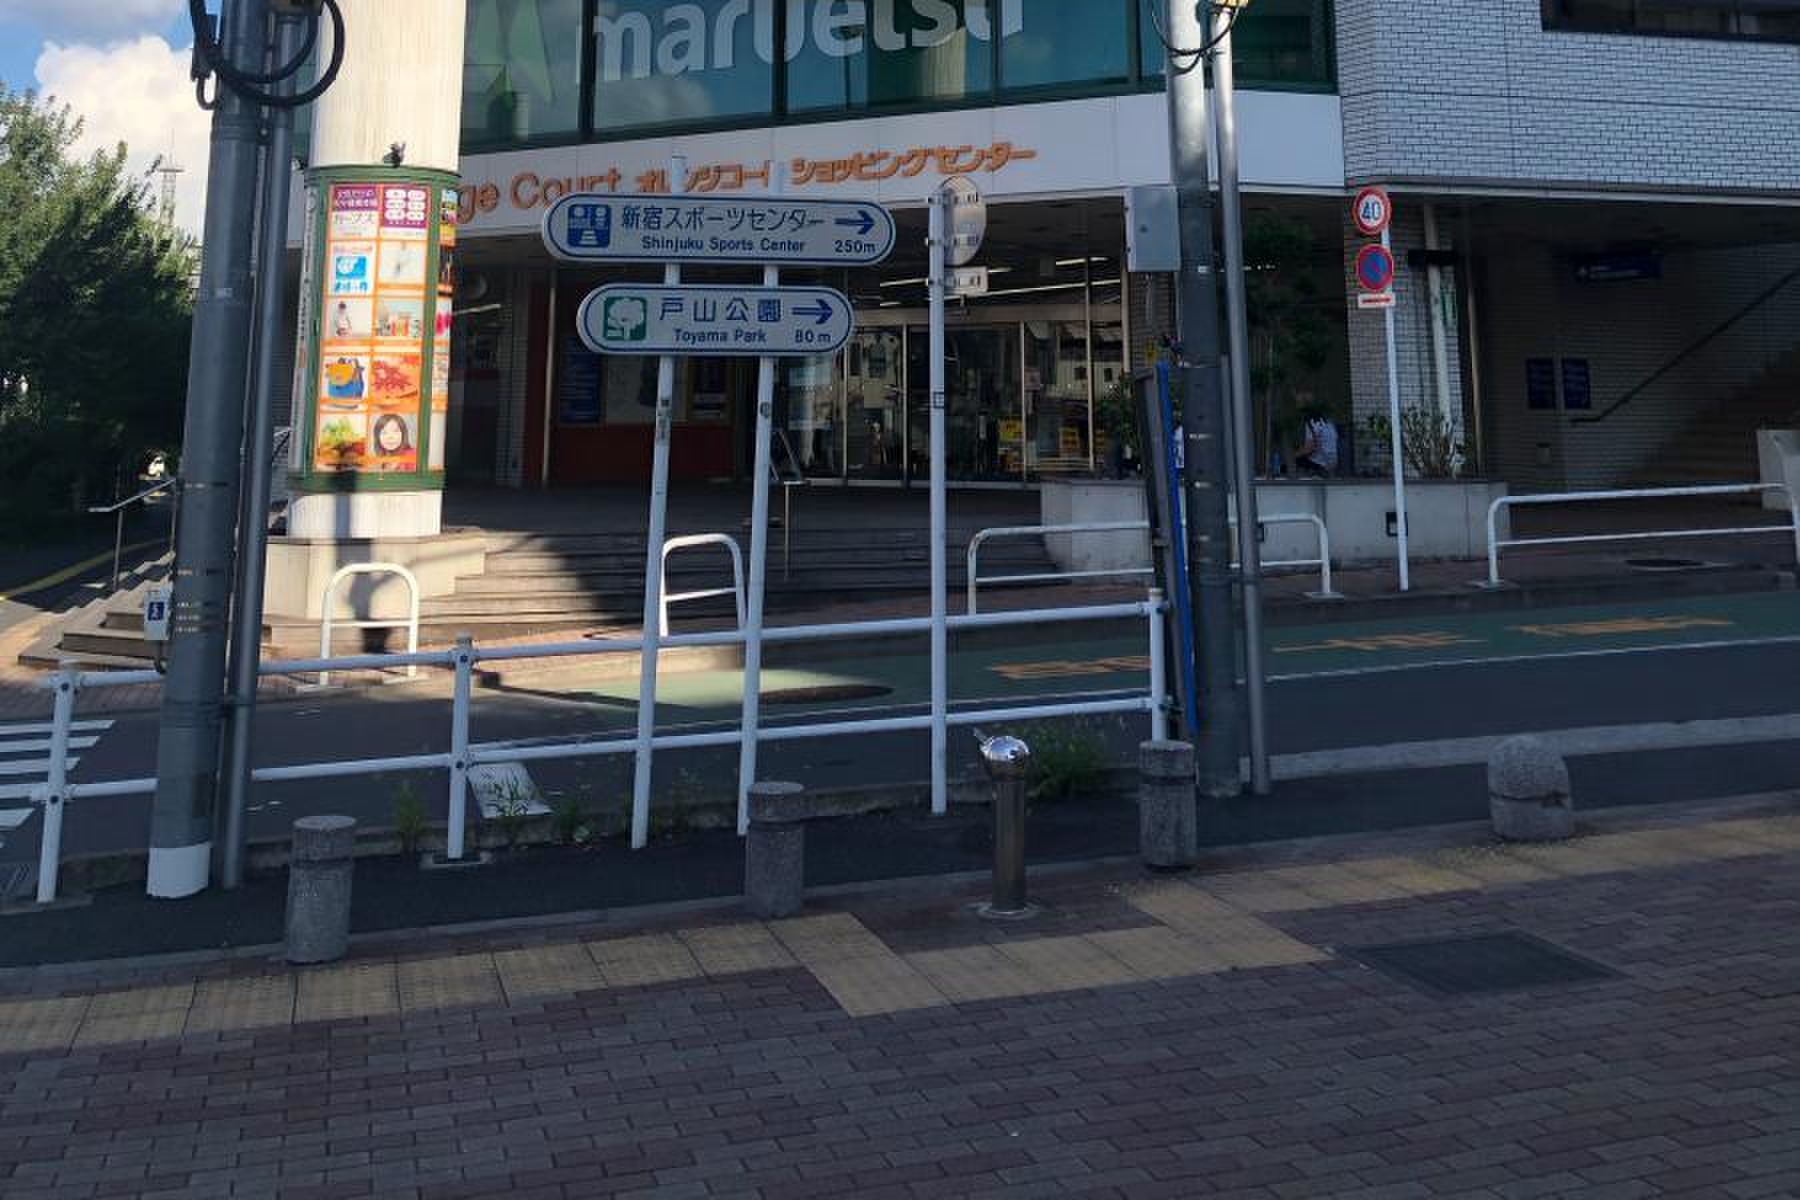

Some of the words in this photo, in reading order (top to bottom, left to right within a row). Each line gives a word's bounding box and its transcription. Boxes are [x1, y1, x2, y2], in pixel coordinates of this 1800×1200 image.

[791, 141, 1037, 186] ショッピングセンター
[621, 207, 824, 232] 新宿スポーツセンター
[1362, 201, 1380, 220] 40
[642, 235, 704, 252] Shinjuku
[709, 237, 752, 253] Sports
[760, 238, 806, 252] Center
[834, 239, 877, 253] 250m
[659, 297, 781, 322] 戸山公園
[674, 329, 728, 344] Toyama
[735, 329, 767, 343] Park
